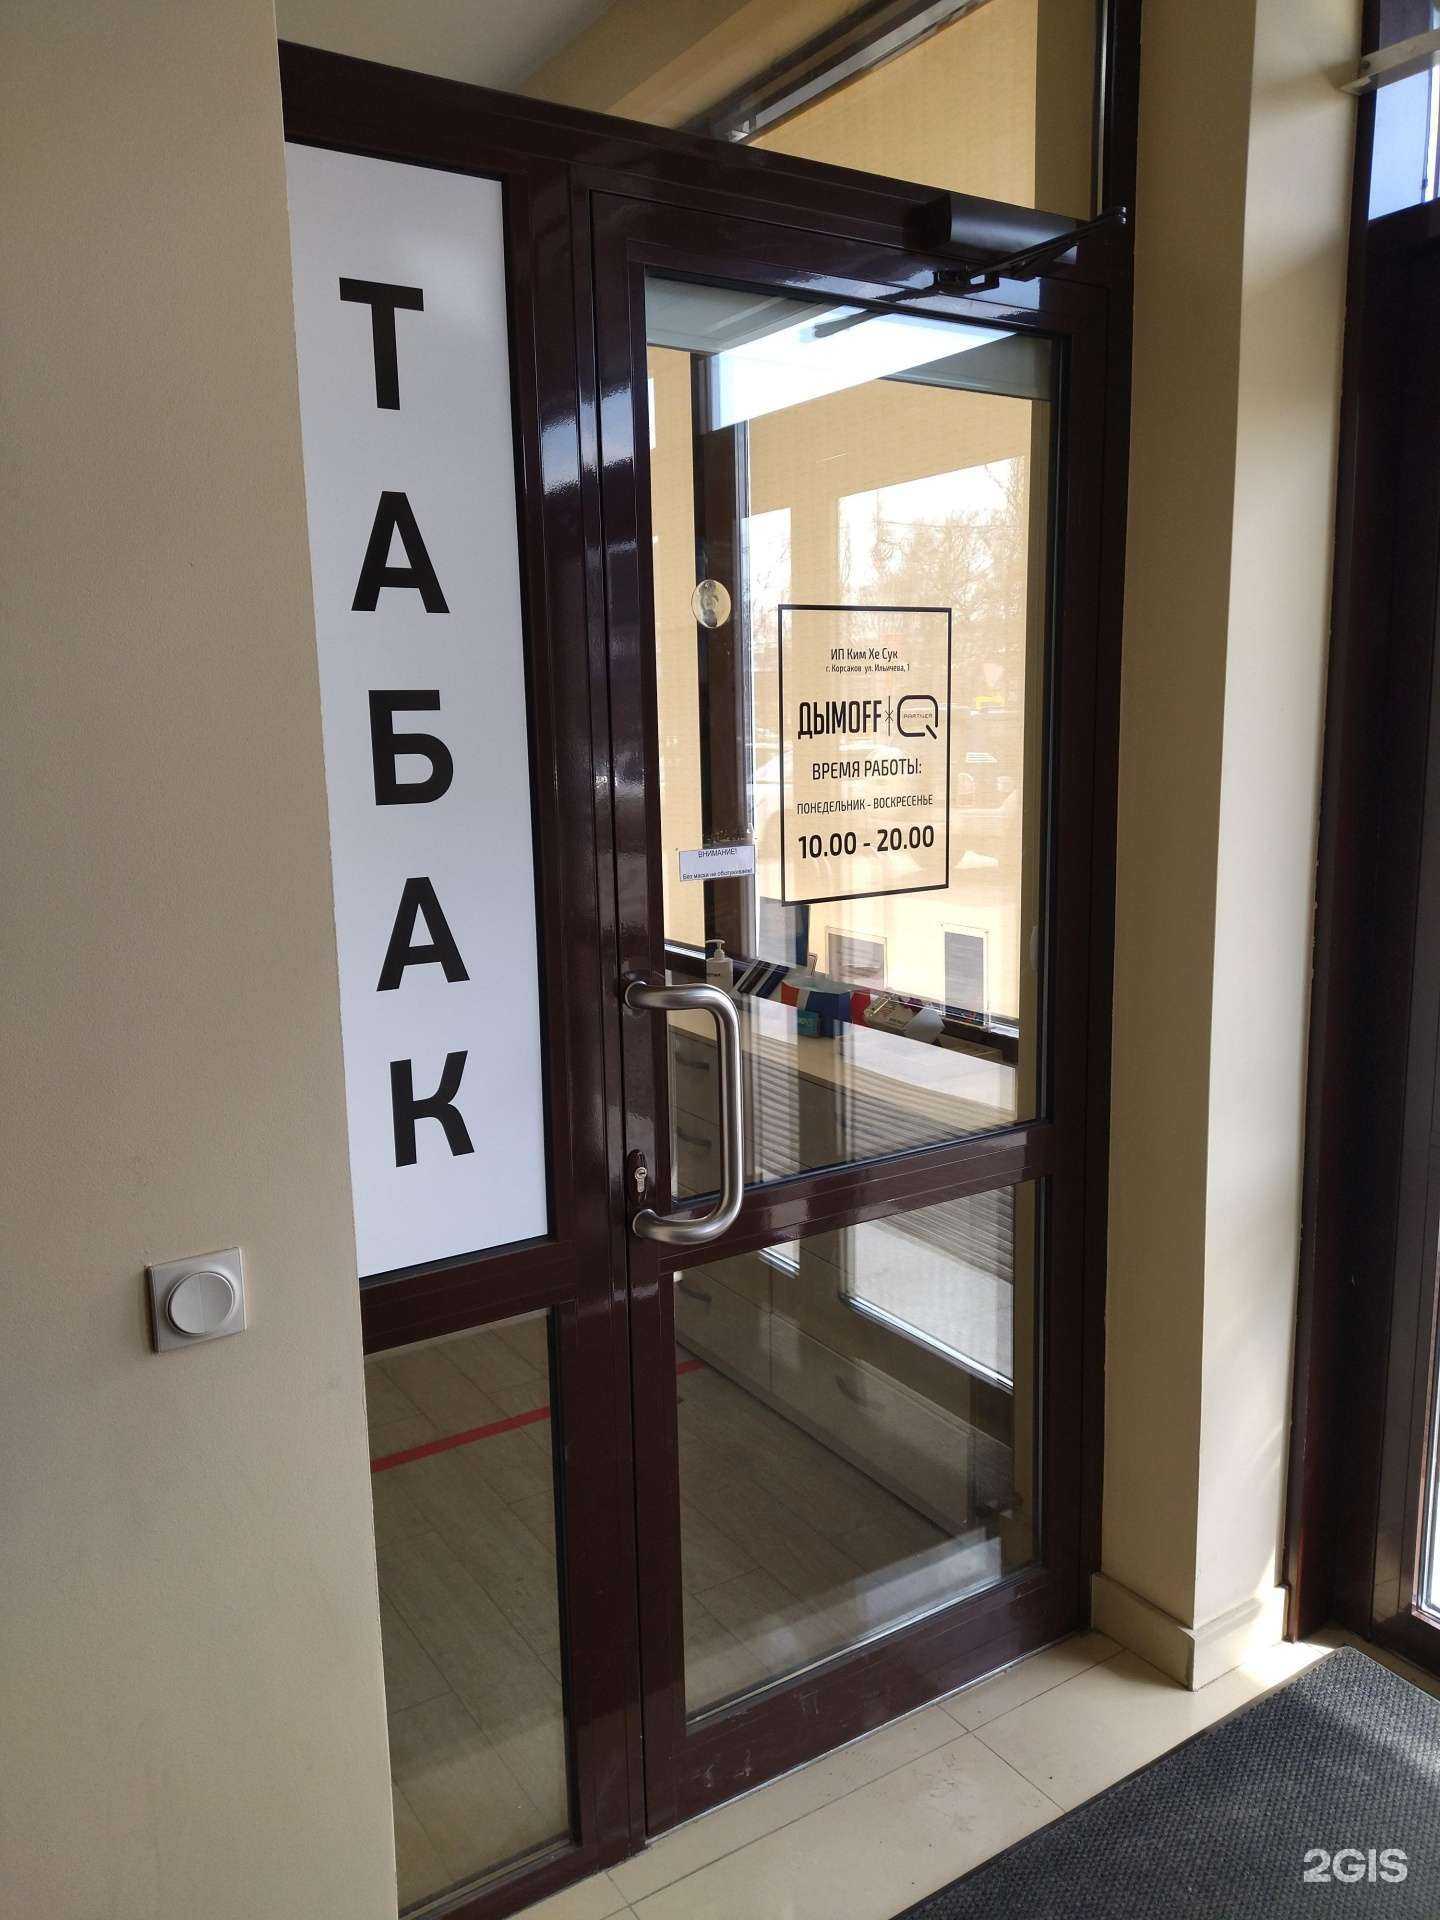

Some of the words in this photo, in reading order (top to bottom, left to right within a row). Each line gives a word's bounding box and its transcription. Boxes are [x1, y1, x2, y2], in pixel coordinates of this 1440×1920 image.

[830, 648, 845, 660] ИП
[847, 648, 867, 660] Ким
[868, 647, 881, 660] Хе
[882, 647, 898, 662] Сук
[831, 664, 862, 674] Корсаков
[864, 665, 874, 674] ул.
[874, 663, 906, 673] Ильичева,
[338, 276, 475, 1168] ТАБАК
[812, 762, 860, 780] ВРЕМЯ
[864, 758, 922, 777] РАБОТЫ:
[797, 799, 866, 815] ПОНЕДЕЛЬНИК
[873, 794, 934, 809] ВОСКРЕСЕНЬЕ
[798, 832, 857, 859] 10.00
[877, 825, 935, 852] 20.00
[697, 848, 738, 858] ВНИМАНИЕ!
